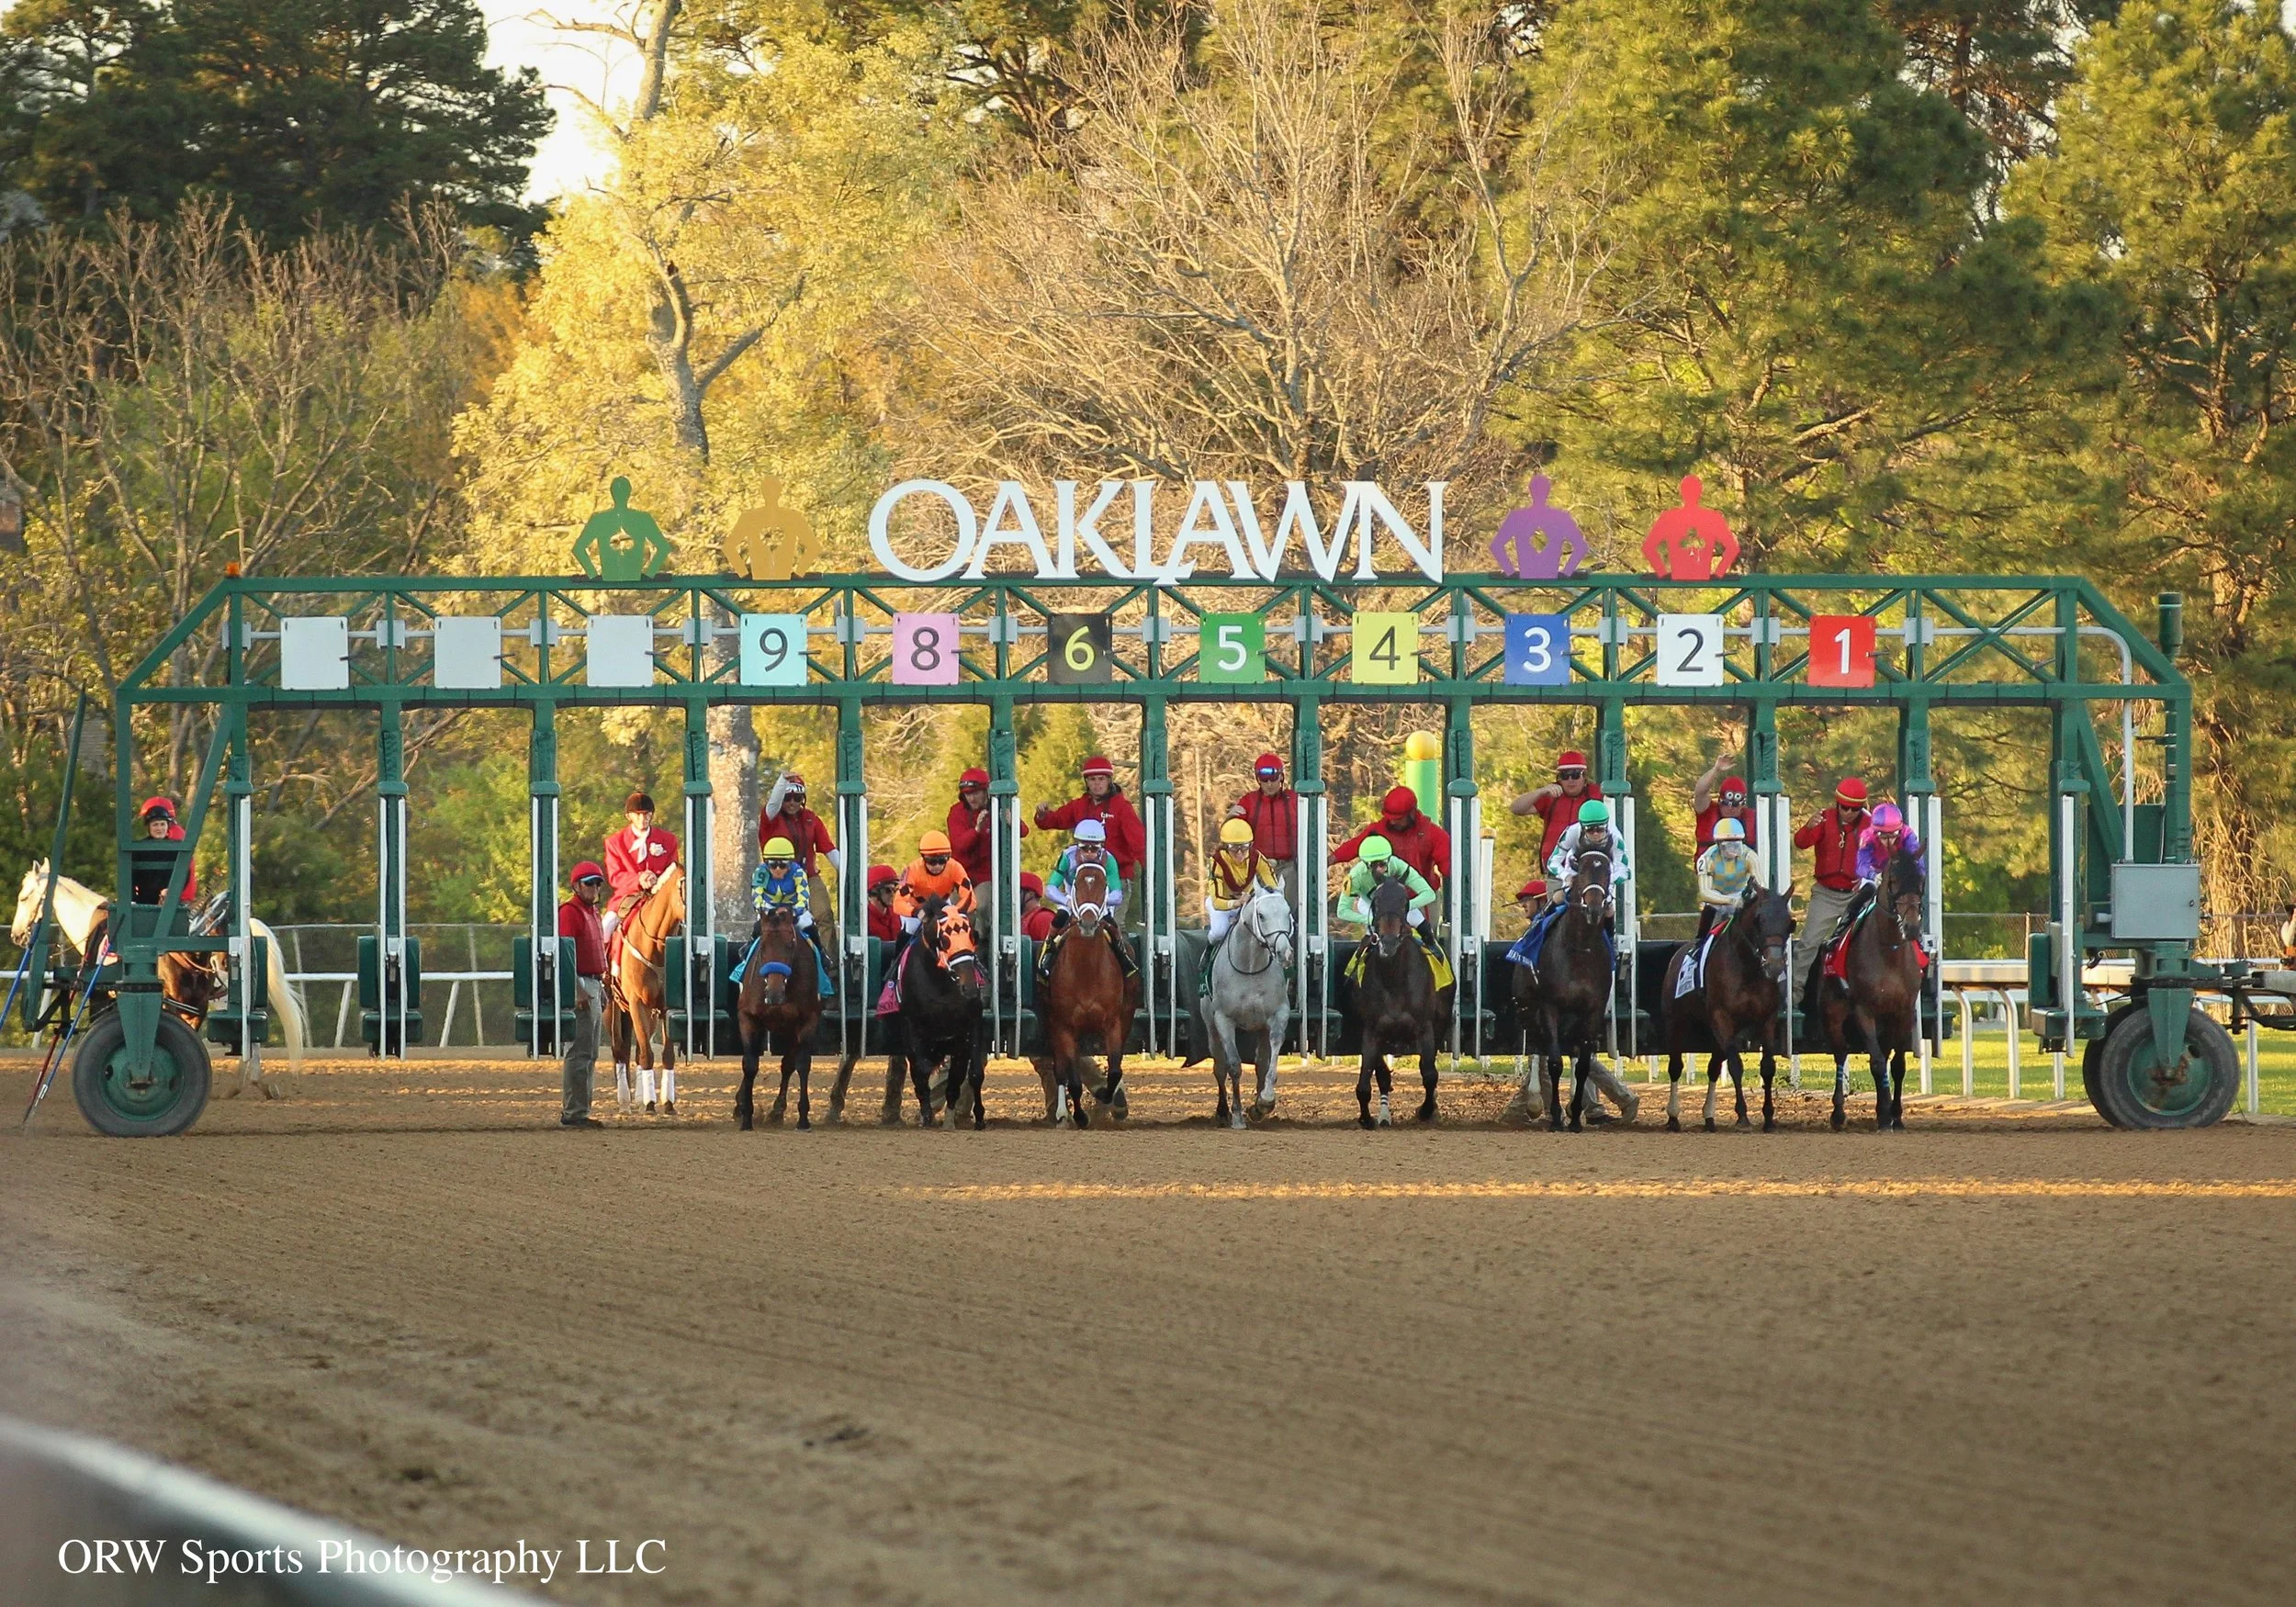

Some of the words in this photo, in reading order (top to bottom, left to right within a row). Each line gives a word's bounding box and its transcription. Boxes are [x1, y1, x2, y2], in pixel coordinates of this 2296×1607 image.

[868, 479, 1448, 585] OAKLAWN
[760, 629, 788, 671] 9
[911, 628, 940, 670] 8
[1064, 626, 1095, 672] 6
[1218, 625, 1247, 671] 5
[1369, 626, 1401, 670] 4
[1523, 627, 1551, 672] 3
[1677, 629, 1704, 671] 2
[1835, 628, 1851, 674] 1
[757, 871, 766, 884] 9
